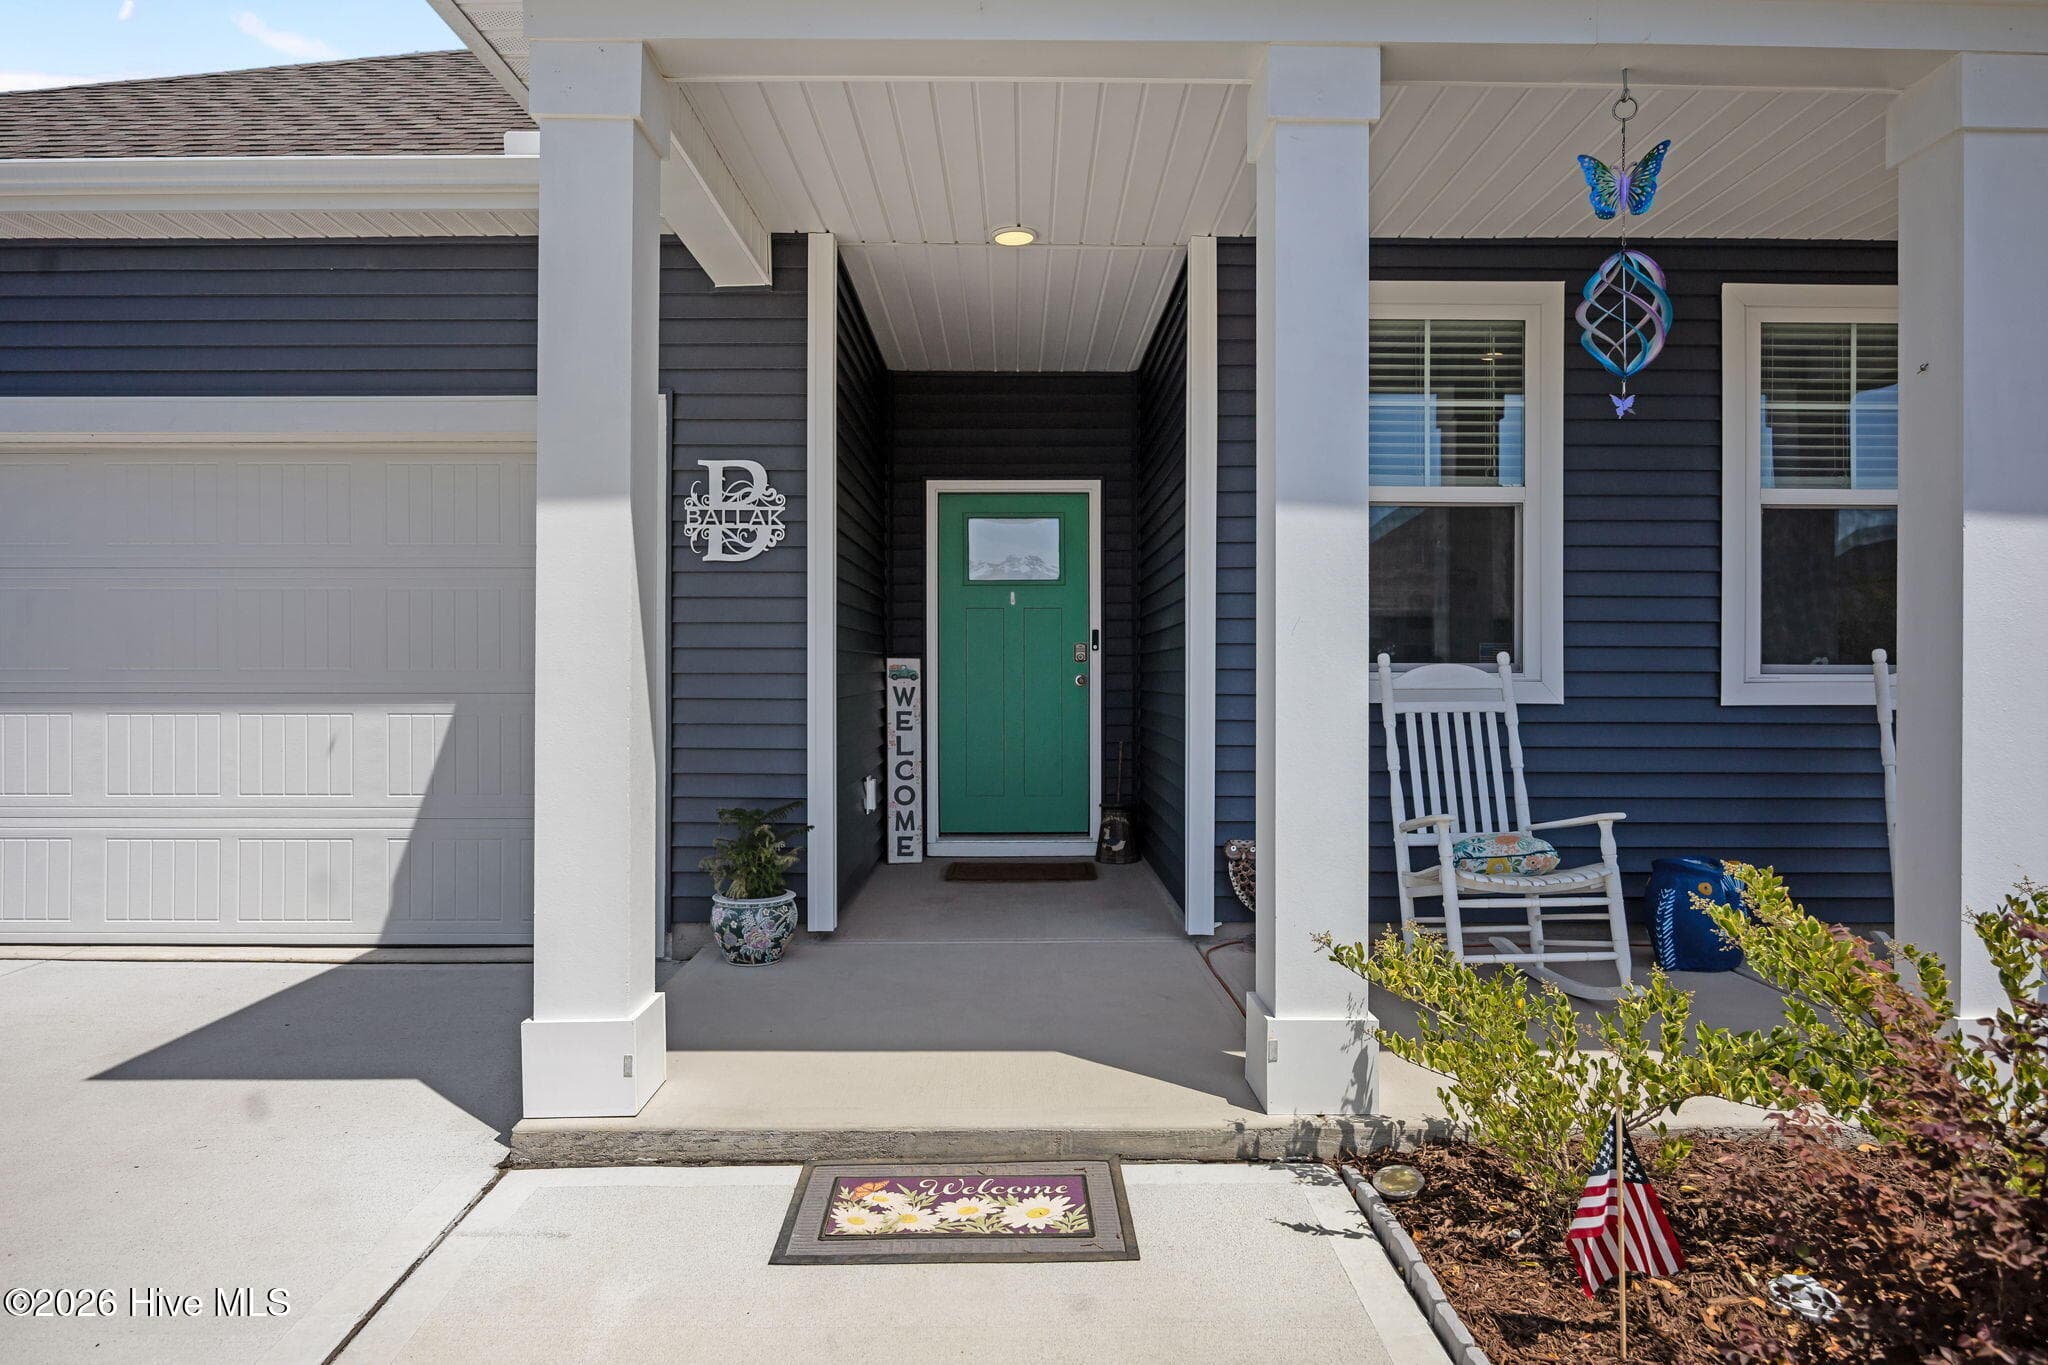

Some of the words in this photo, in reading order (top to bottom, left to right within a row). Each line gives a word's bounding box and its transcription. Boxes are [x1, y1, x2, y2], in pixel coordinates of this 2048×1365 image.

[686, 506, 786, 529] BALLAK
[892, 685, 916, 858] WELCOME
[919, 1178, 1069, 1196] Welcome
